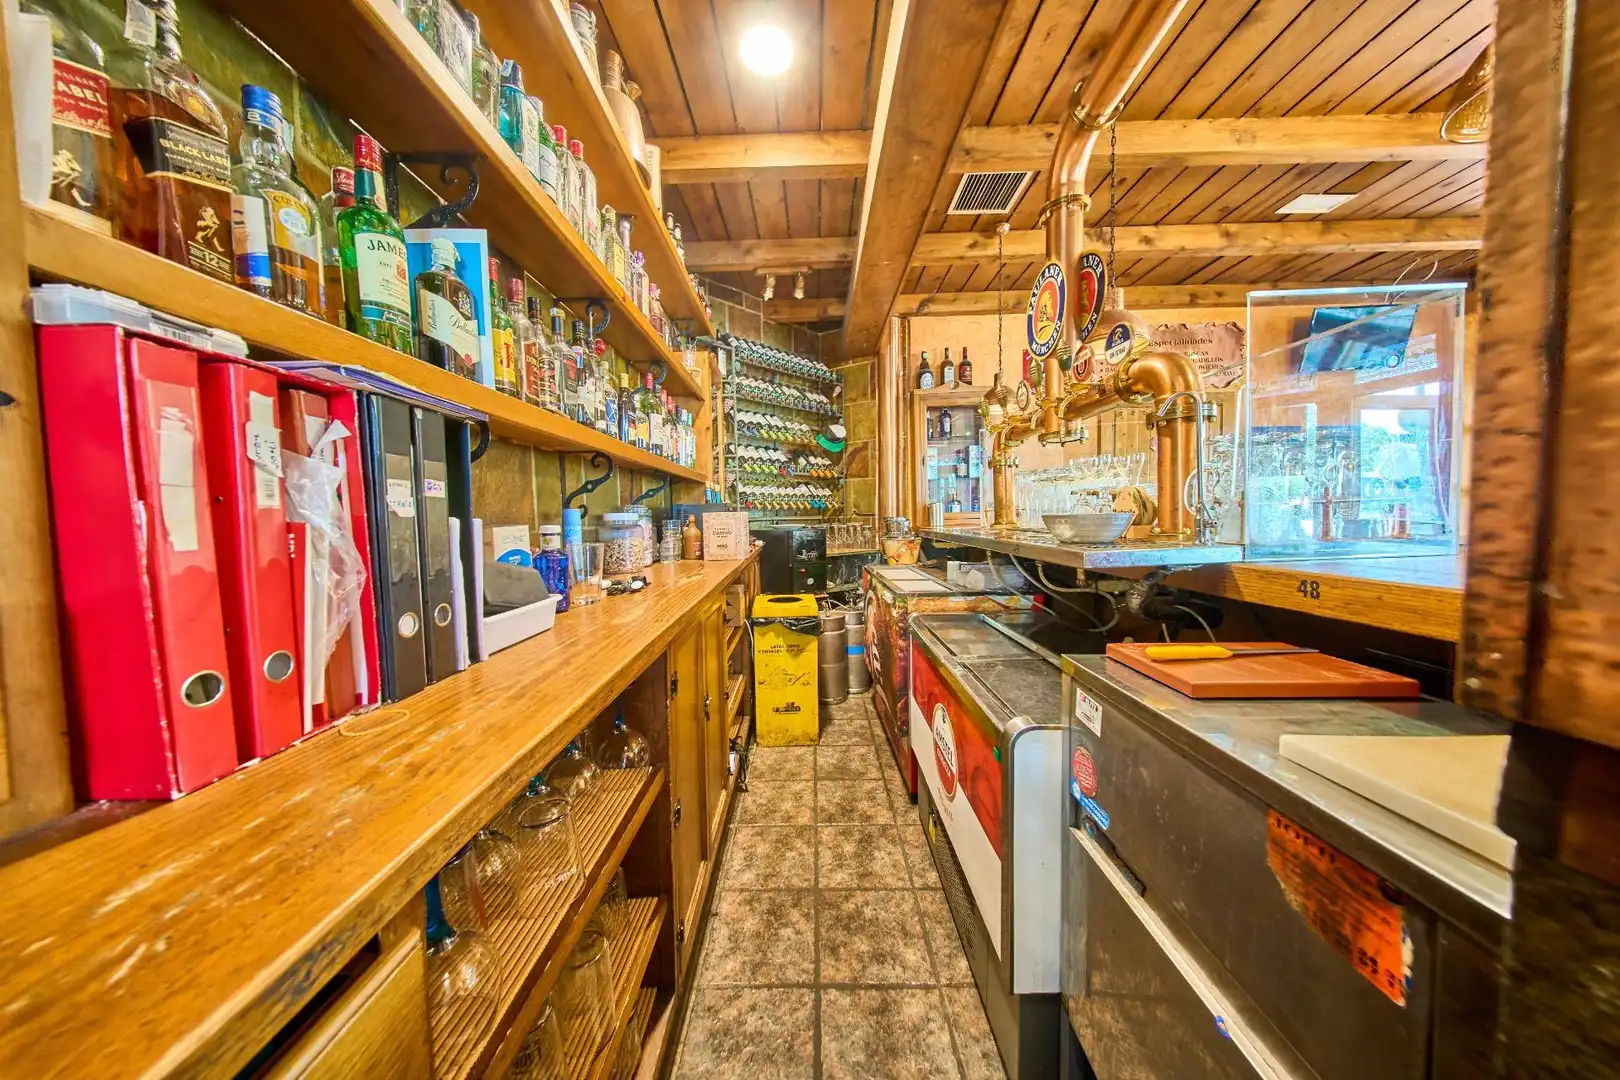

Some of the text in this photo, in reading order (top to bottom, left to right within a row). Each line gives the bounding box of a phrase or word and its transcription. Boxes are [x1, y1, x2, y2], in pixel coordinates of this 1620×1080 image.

[53, 80, 109, 106] ABEL
[159, 139, 202, 158] BLACK
[203, 251, 219, 267] 12
[1082, 254, 1103, 278] ANER
[1028, 264, 1063, 316] PAULANER
[1031, 320, 1061, 355] MÜNCHEN
[1148, 337, 1213, 348] Especialidades
[1297, 579, 1321, 600] 48
[936, 726, 954, 767] AMSTEL
